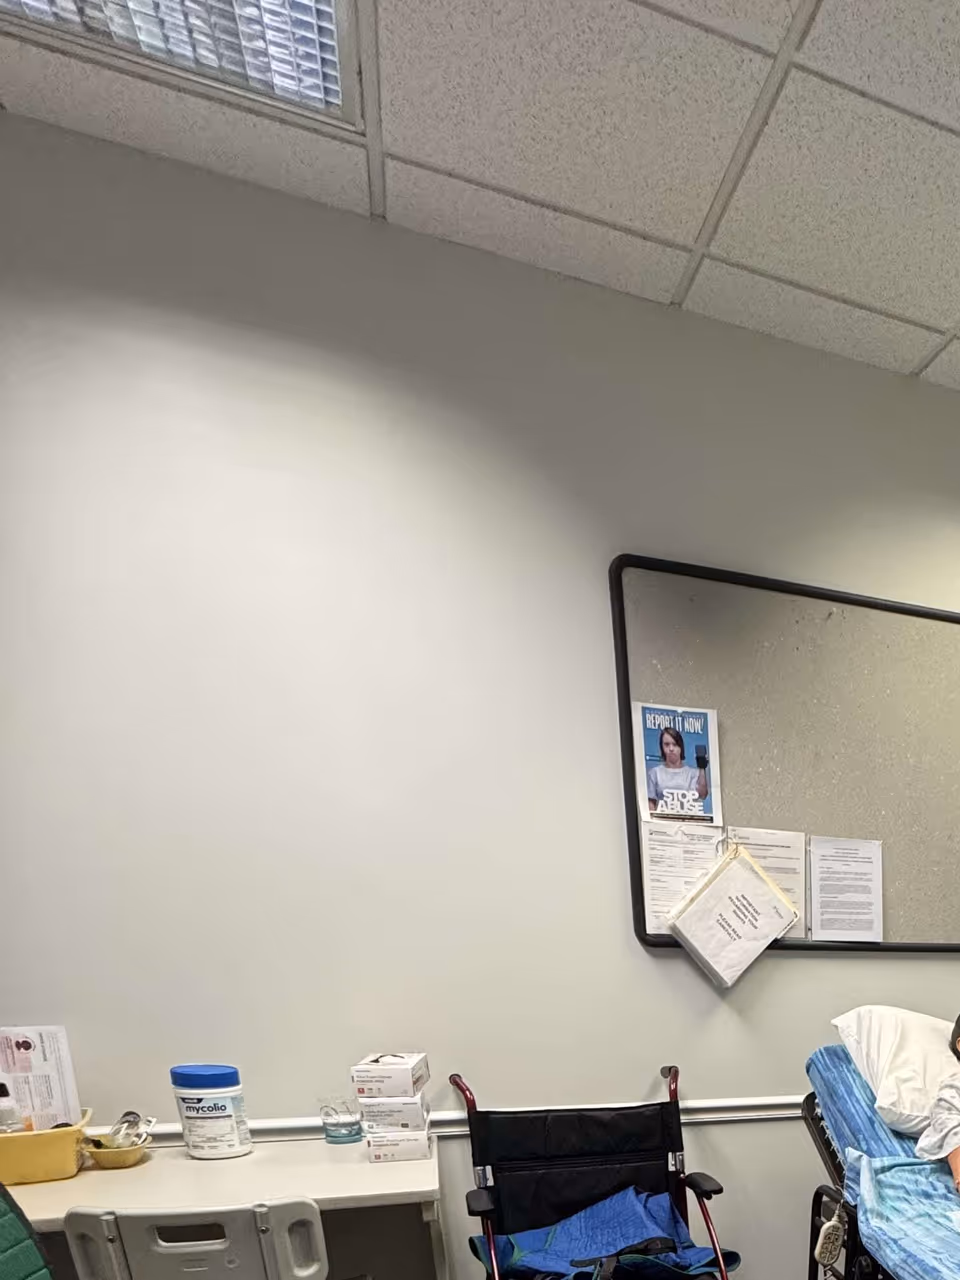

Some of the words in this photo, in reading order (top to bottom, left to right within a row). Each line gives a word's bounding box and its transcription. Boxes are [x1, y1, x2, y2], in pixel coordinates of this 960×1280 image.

[646, 713, 674, 729] REPORT
[675, 716, 683, 731] IT
[684, 717, 704, 734] NOW!
[663, 789, 700, 802] STOP
[656, 799, 704, 814] ABUSE
[736, 895, 758, 922] INFORMATION
[741, 894, 760, 916] IMPORTANT
[185, 1103, 227, 1114] mycolio
